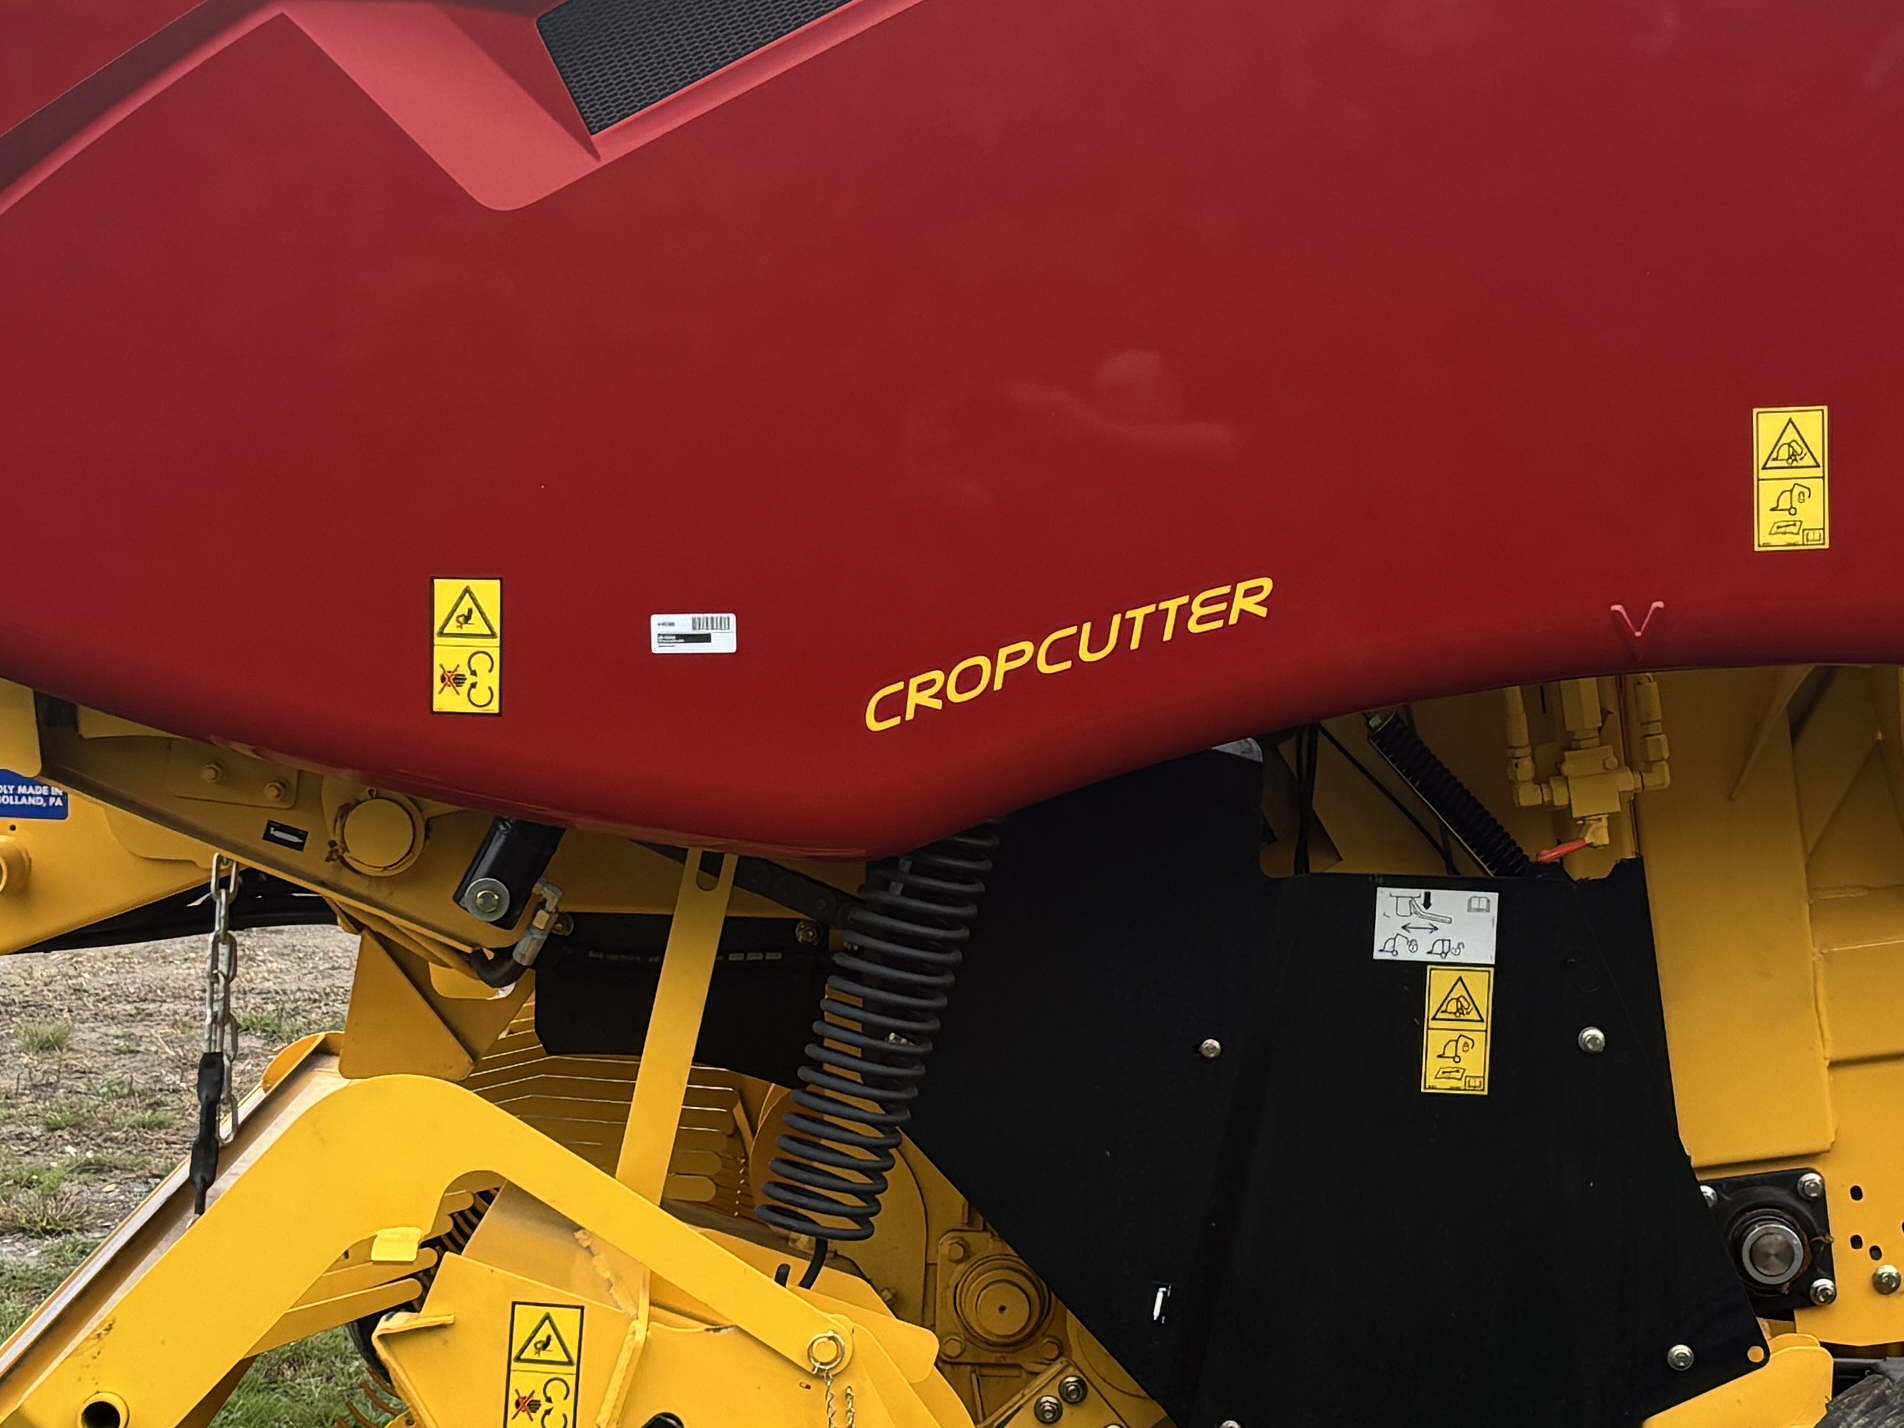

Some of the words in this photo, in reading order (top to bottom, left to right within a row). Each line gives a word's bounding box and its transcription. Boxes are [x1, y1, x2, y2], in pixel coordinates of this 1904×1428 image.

[865, 577, 1273, 731] CROPCUTTER
[17, 785, 49, 795] MADE
[49, 797, 63, 806] PA
